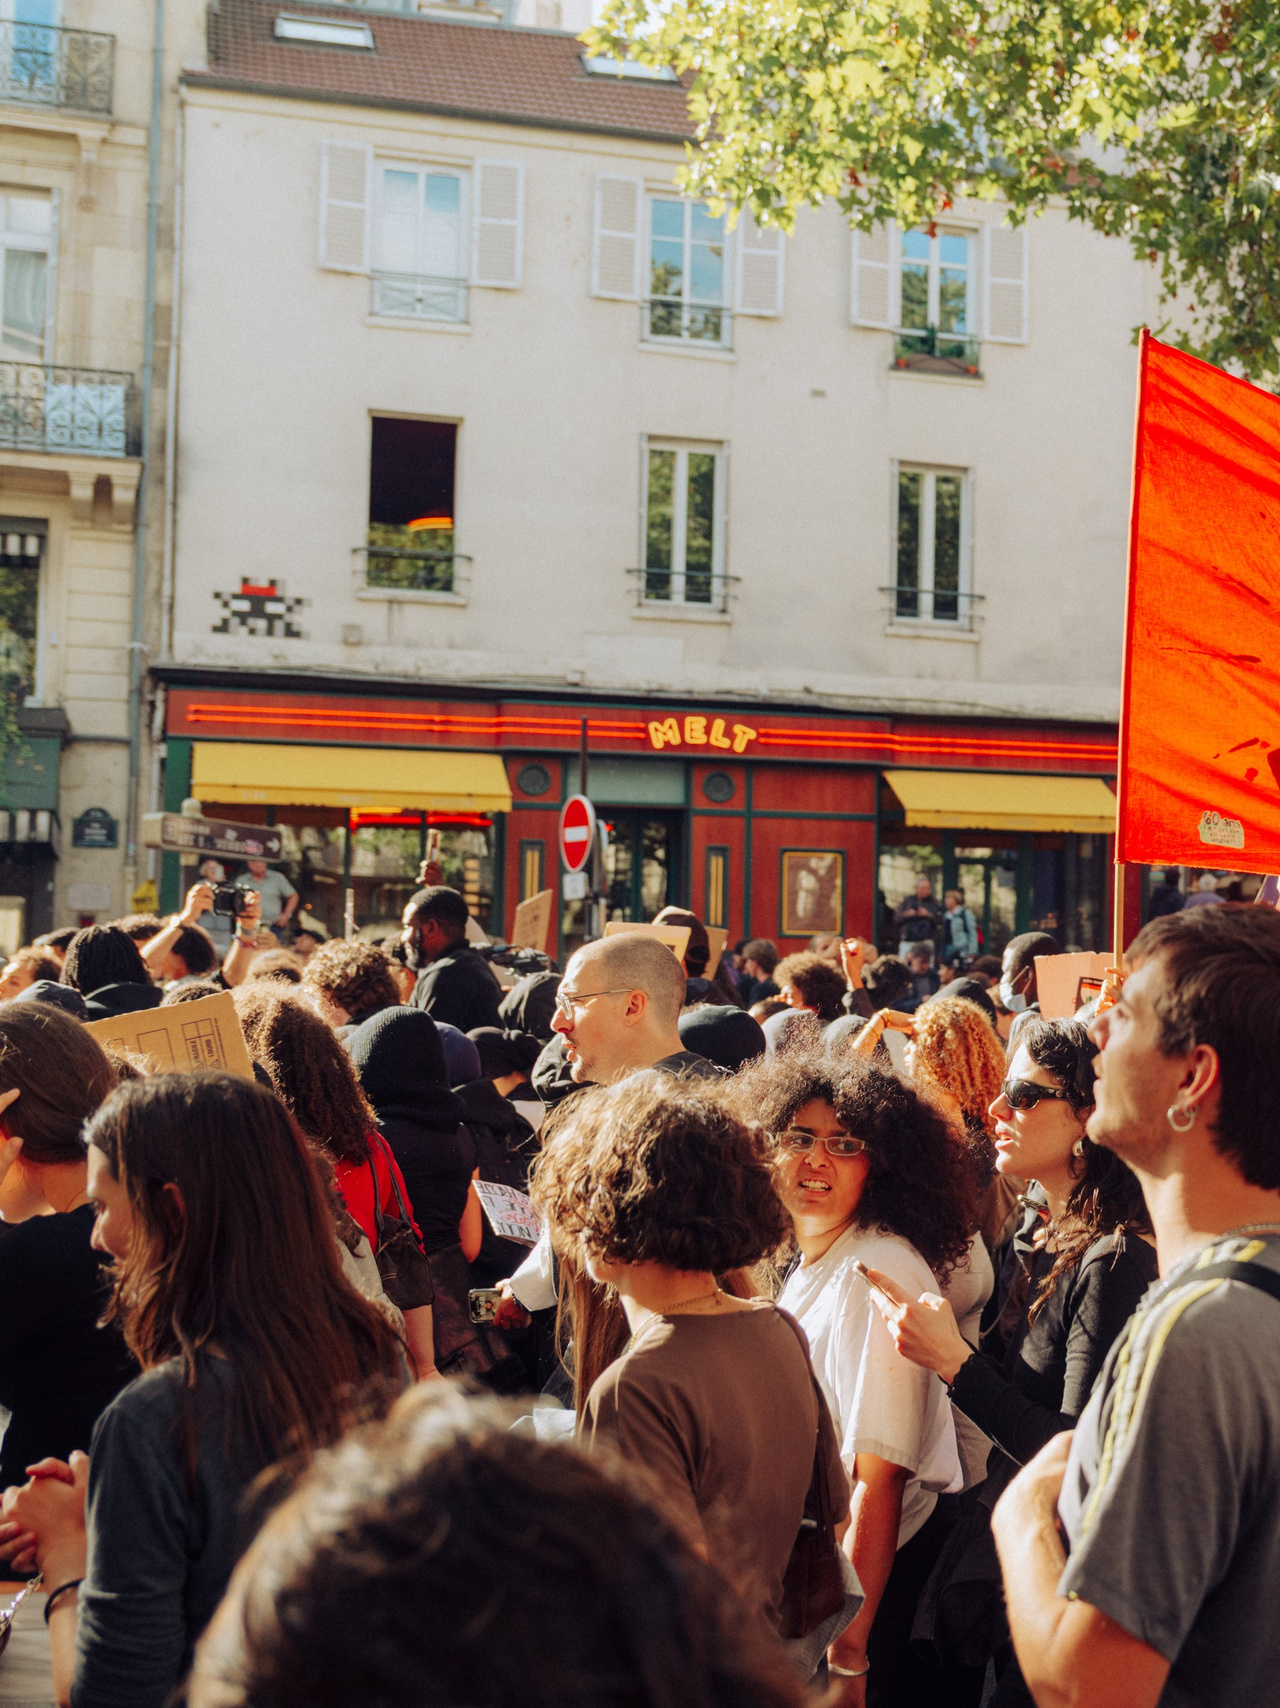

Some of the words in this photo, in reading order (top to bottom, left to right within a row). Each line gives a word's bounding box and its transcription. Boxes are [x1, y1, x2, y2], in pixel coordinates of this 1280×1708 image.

[648, 716, 757, 754] MELT
[1202, 811, 1220, 826] 60
[1223, 818, 1241, 829] ans
[190, 1040, 200, 1063] FRAGILE
[205, 1039, 214, 1058] LOURD
